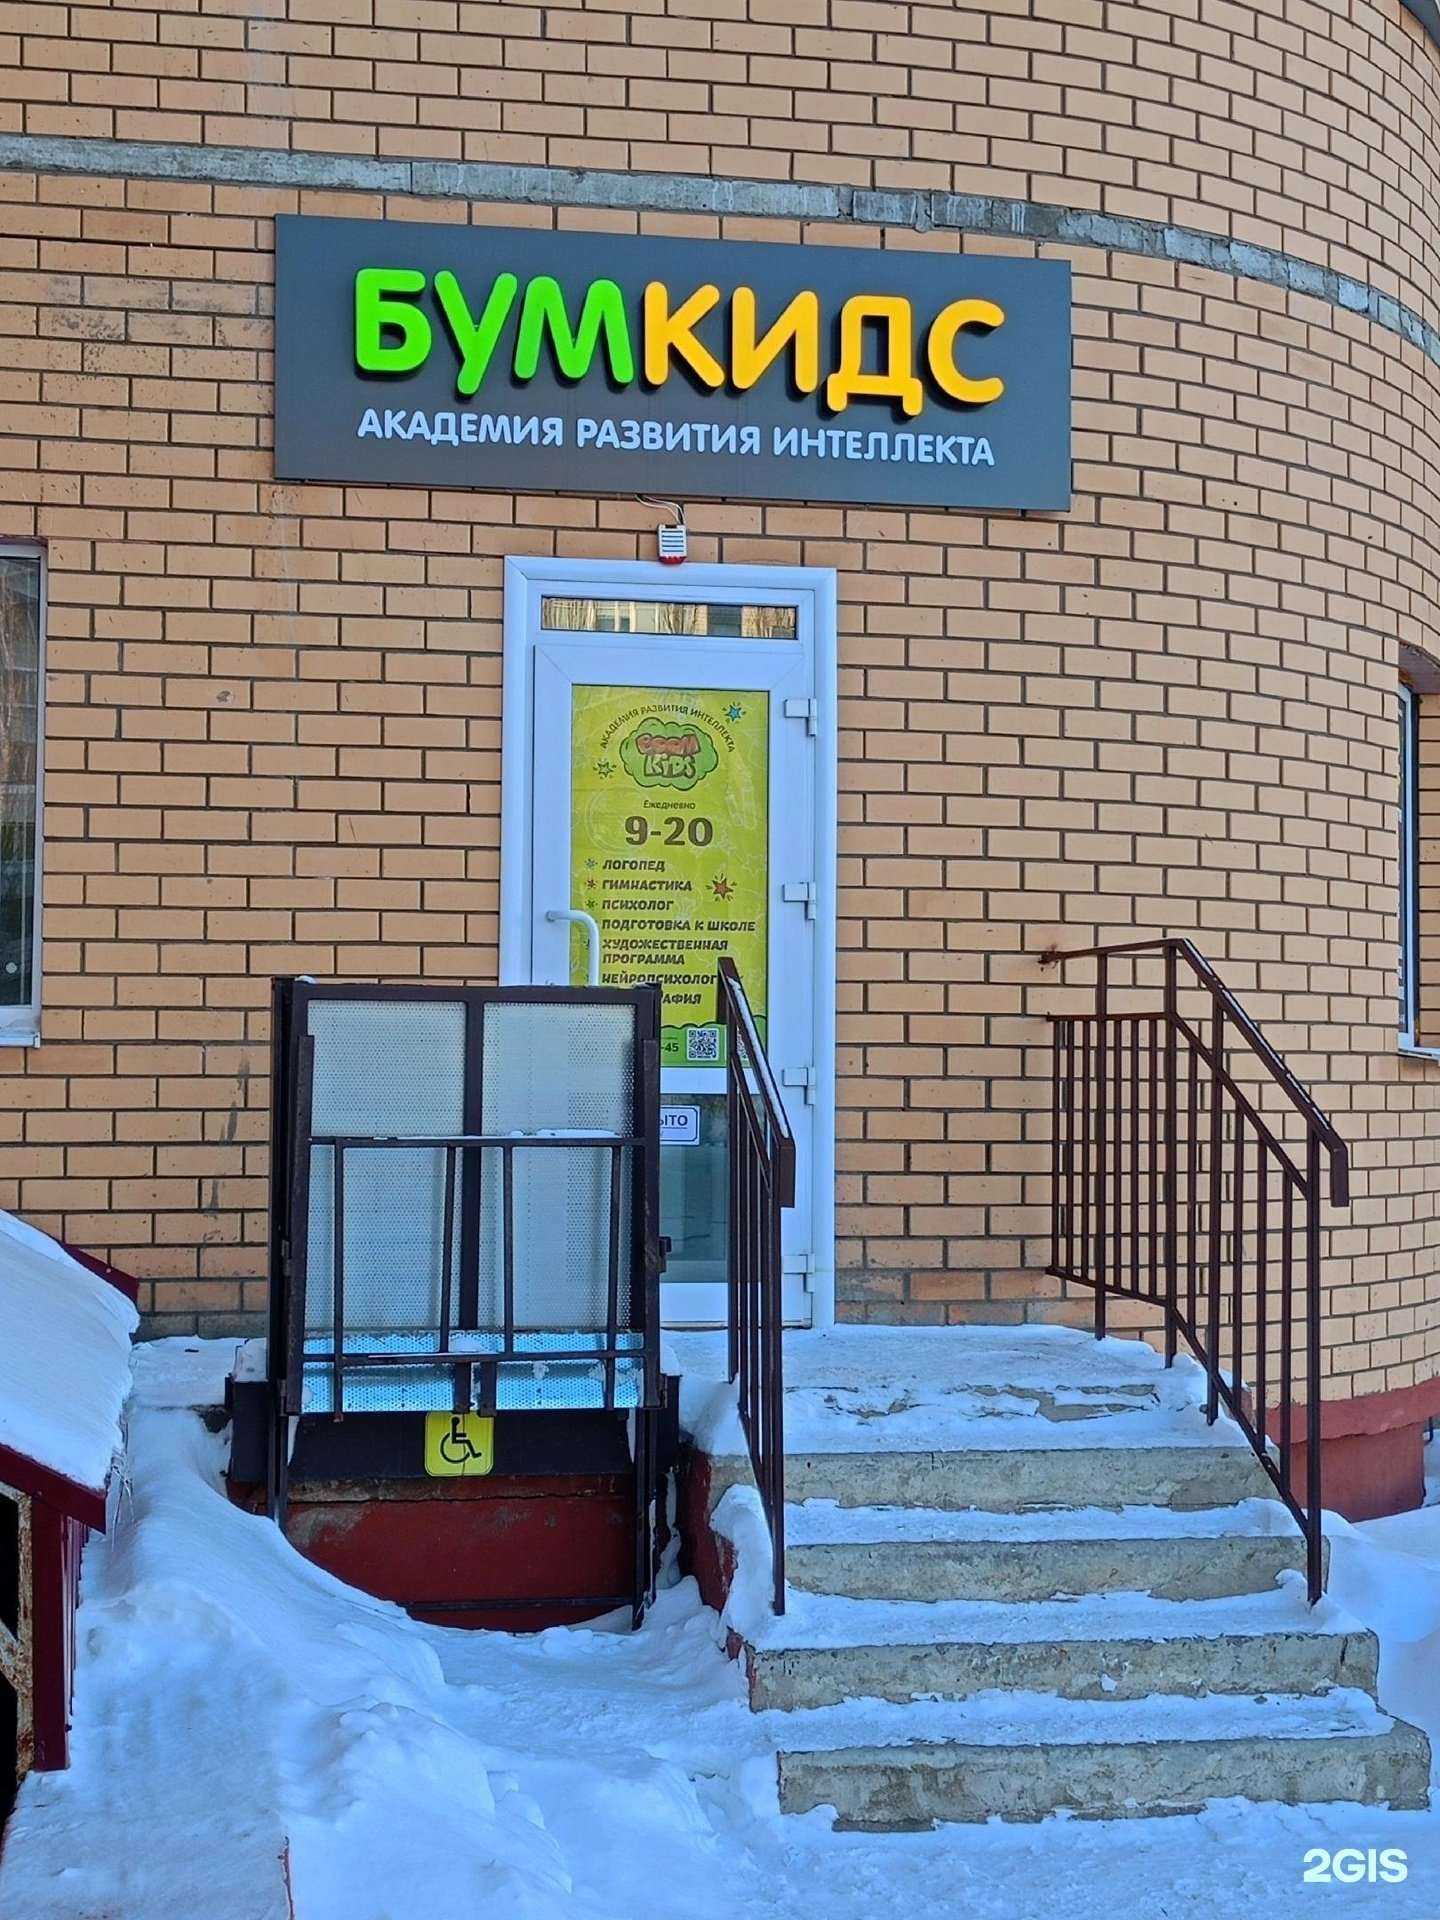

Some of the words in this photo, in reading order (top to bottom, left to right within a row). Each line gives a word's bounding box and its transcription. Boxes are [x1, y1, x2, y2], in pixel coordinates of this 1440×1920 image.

[355, 267, 1006, 417] БУМКИДС
[357, 407, 564, 446] АКАДЕМИЯ
[576, 418, 761, 456] РАЗВИТИЯ
[772, 427, 996, 467] ИНТЕЛЛЕКТА
[601, 708, 640, 749] АКАДЕМИЯ
[641, 704, 689, 716] РАЗВИТИЯ
[690, 708, 736, 752] ИНТЕЛЛЕКТА
[643, 799, 696, 810] Ежедневно
[624, 815, 714, 847] 9-20
[602, 859, 665, 872] ЛОГОПЕД
[602, 879, 693, 892] ГИМНАСТИКА
[601, 899, 674, 911] ПСИХОЛОГ
[602, 919, 691, 931] ПОДГОТОВКА
[694, 921, 704, 931] К
[707, 921, 756, 932] ШКОЛЕ
[602, 938, 728, 951] ХУДОЖЕСТВЕННАЯ
[602, 953, 685, 965] ПРОГРАММА
